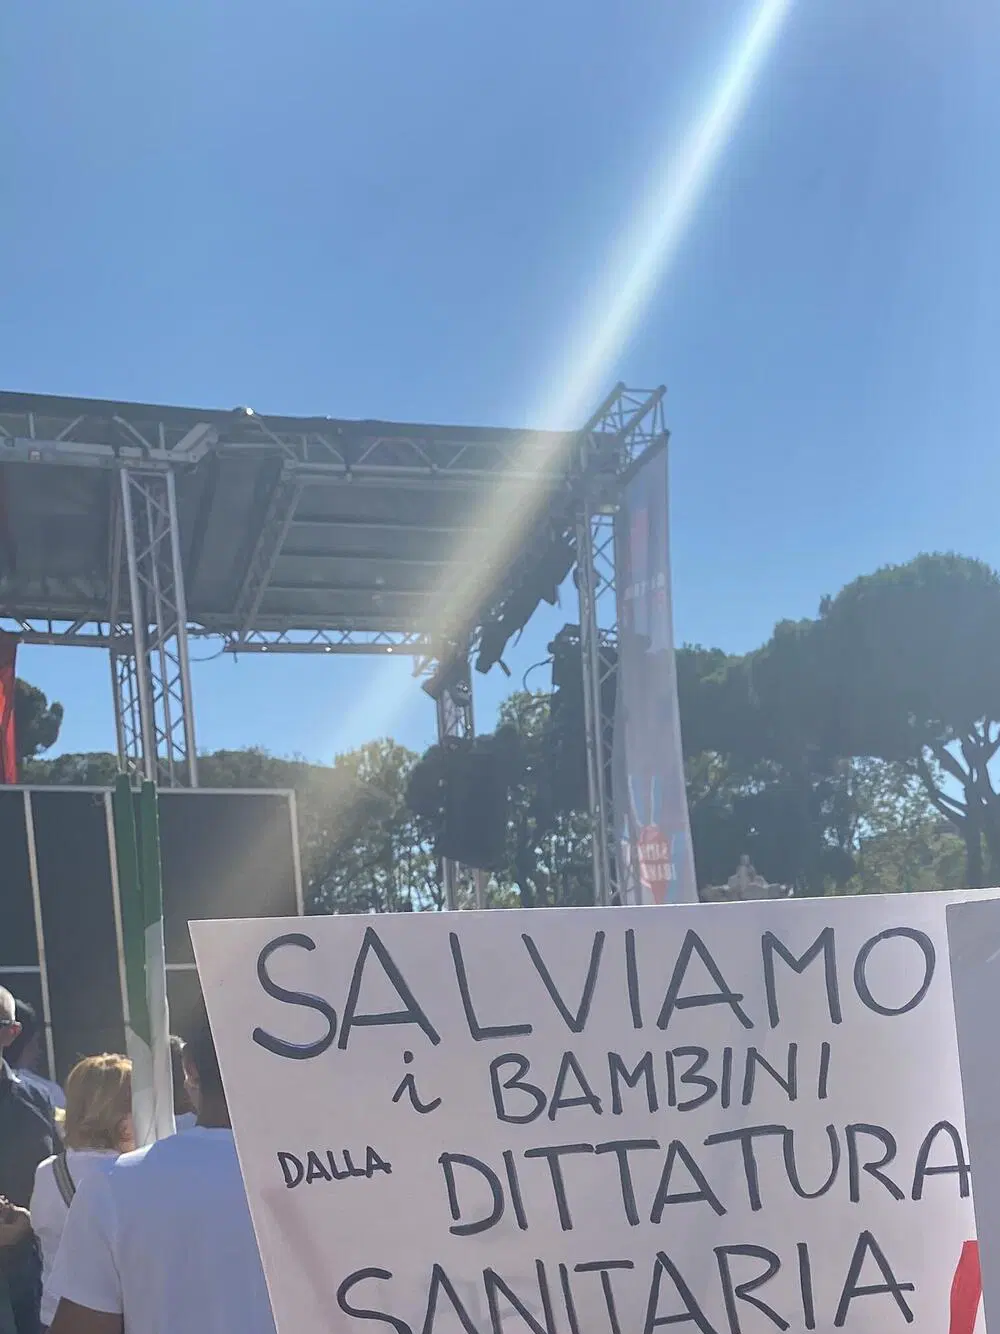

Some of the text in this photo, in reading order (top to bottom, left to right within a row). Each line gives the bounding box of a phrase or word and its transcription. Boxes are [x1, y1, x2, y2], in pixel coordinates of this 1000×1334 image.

[252, 926, 936, 1060] SALVIAMO
[391, 1042, 831, 1125] i BAMBINI
[276, 1120, 971, 1236] DALLA DITTATURA
